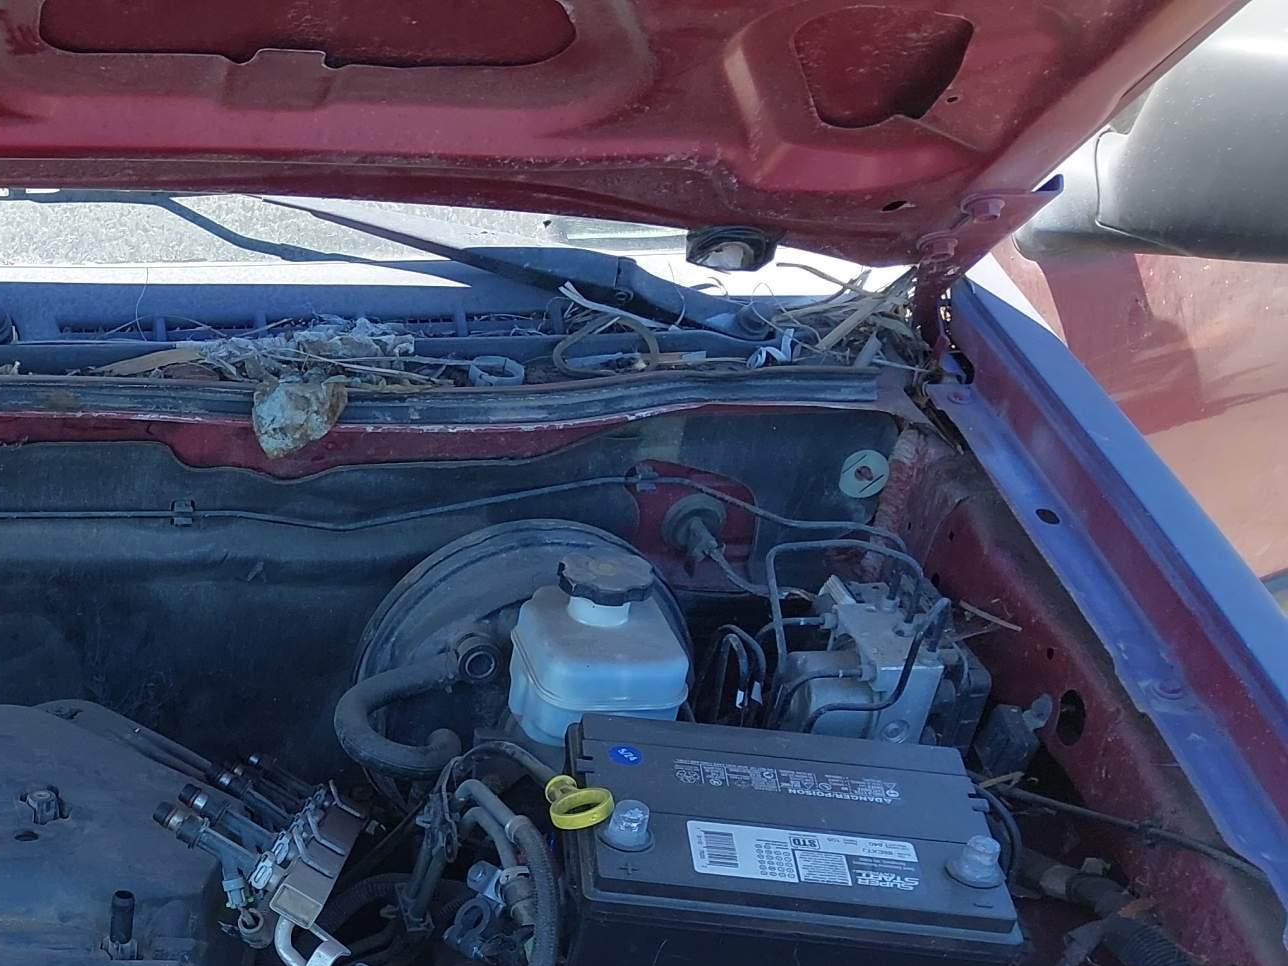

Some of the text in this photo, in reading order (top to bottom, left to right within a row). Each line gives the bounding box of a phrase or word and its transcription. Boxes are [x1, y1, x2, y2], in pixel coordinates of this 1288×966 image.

[788, 788, 883, 804] DANGER/POISON
[793, 838, 817, 848] STD
[856, 873, 920, 886] START
[857, 878, 915, 891] SUPER
